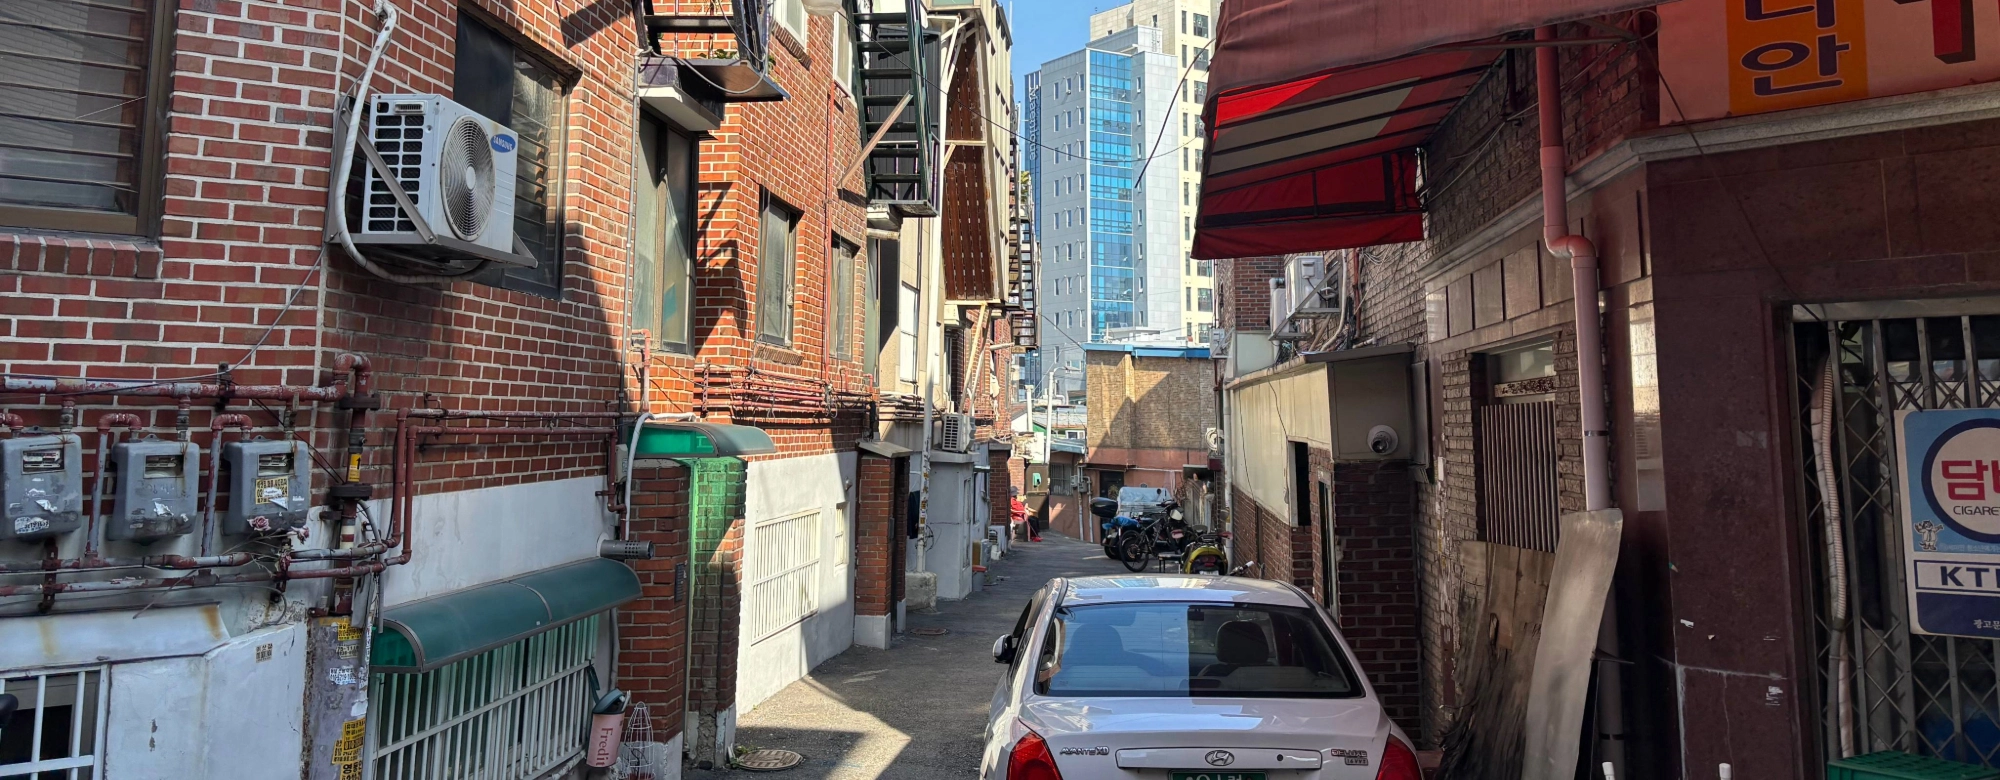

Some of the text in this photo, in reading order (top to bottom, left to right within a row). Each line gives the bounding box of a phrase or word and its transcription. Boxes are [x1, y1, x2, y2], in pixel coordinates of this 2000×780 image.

[493, 135, 513, 151] SAMSUNG
[1941, 460, 2000, 501] 담
[1953, 505, 2000, 517] CIGARE
[1940, 566, 2000, 588] KT
[596, 727, 614, 766] Fredit
